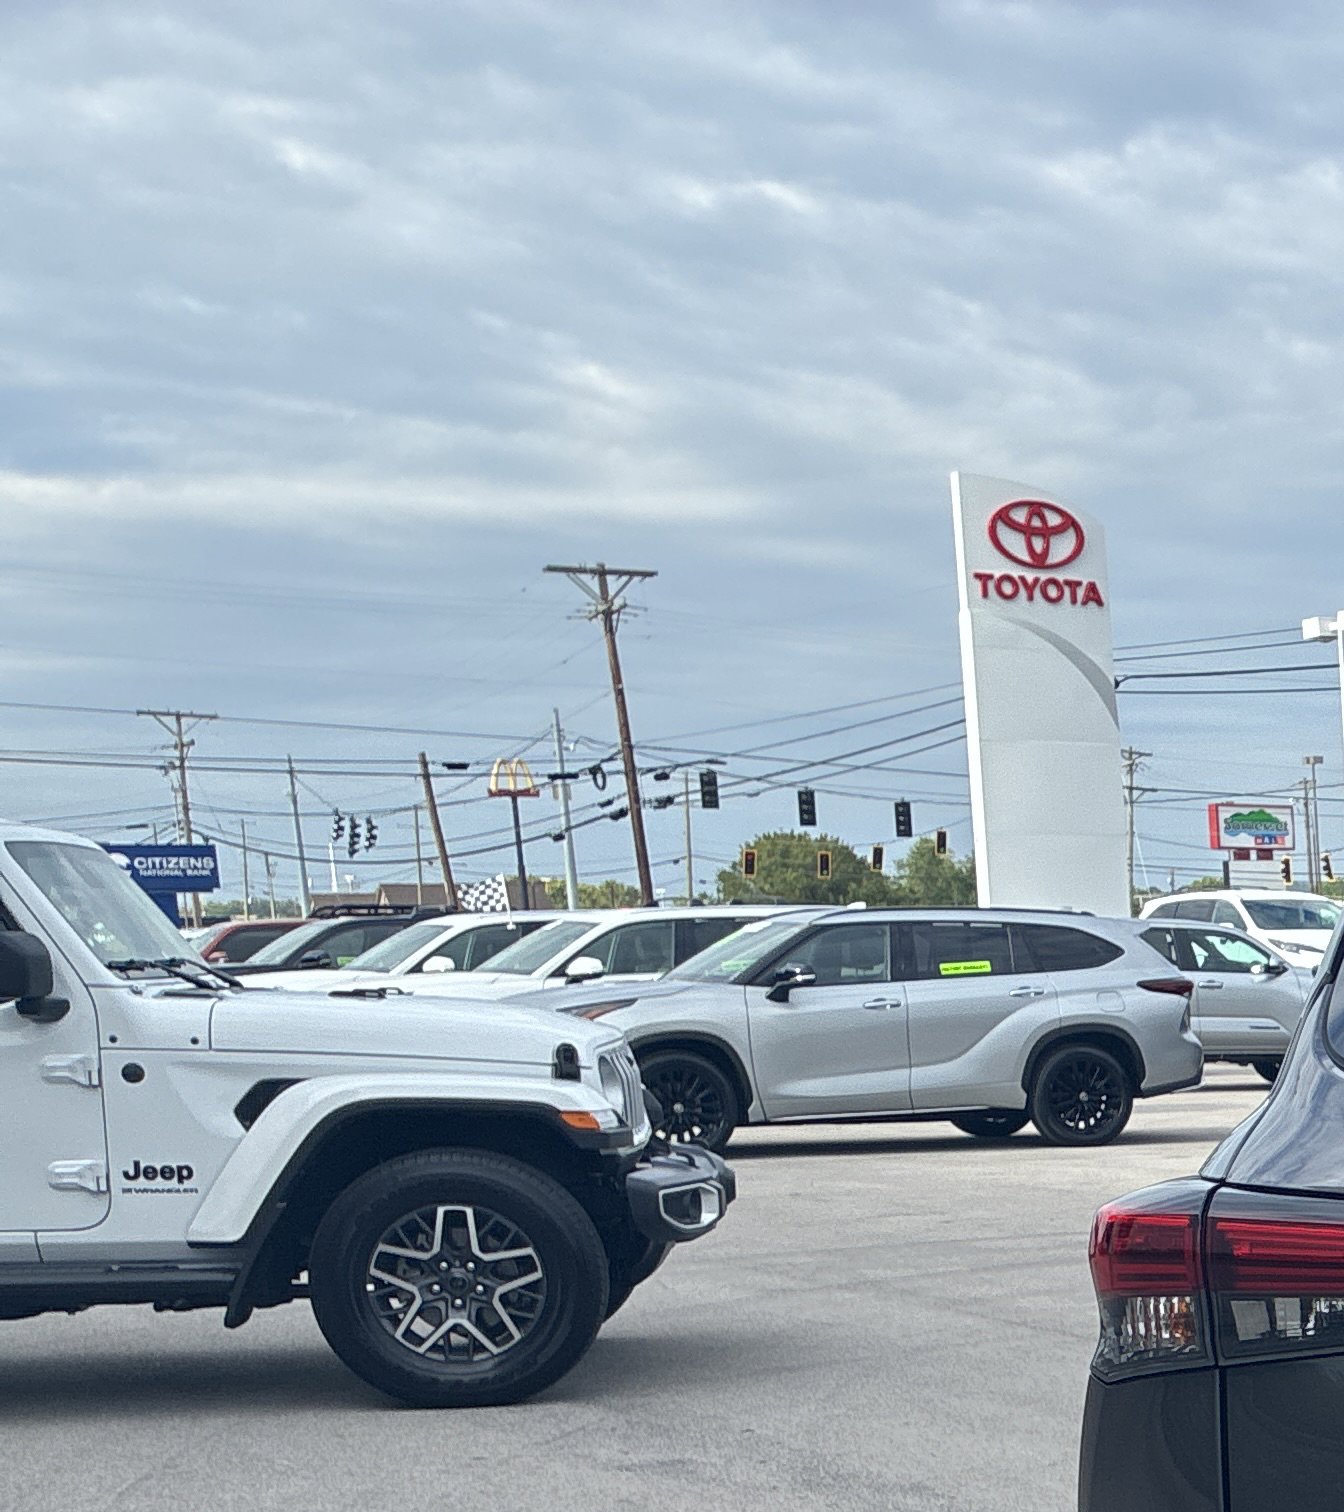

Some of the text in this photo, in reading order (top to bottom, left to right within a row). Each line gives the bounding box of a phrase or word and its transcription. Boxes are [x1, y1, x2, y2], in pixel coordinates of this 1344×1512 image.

[973, 572, 1104, 608] TOYOTA
[133, 856, 215, 870] CITIZENS
[139, 868, 211, 877] NATIONAL BANK
[122, 1160, 194, 1185] Jeep
